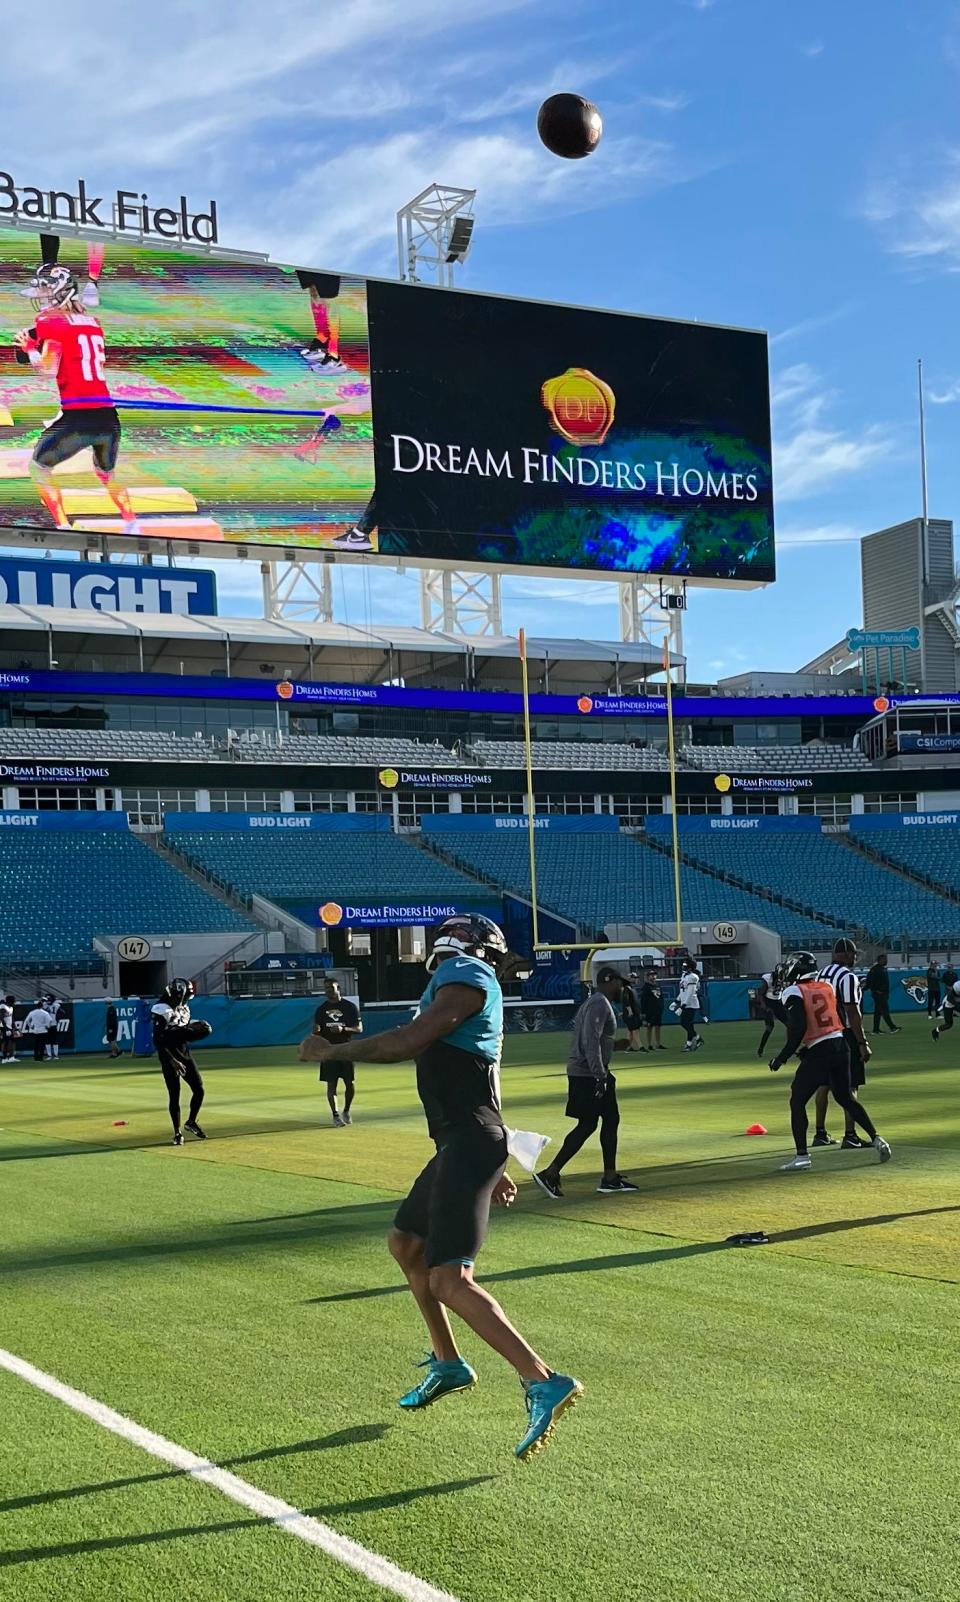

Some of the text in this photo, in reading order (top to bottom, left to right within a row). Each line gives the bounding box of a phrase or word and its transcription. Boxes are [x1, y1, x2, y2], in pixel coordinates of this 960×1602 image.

[0, 171, 218, 243] Bank Field
[391, 434, 758, 501] DREAM FINDERS HOMES
[18, 570, 198, 615] LIGHT
[865, 634, 879, 643] Pet
[296, 685, 322, 695] DREAM
[323, 686, 352, 697] FINDERS
[353, 688, 377, 698] HOMES
[594, 700, 618, 709] DREAM
[619, 700, 646, 710] FINDERS
[0, 765, 110, 777] DREAM FINDERS HOMES
[401, 773, 492, 784] DREAM FINDERS HOMES
[732, 777, 813, 787] DREAM FINDERS HOMES
[0, 815, 39, 826] LIGHT
[249, 817, 312, 827] BUD LIGHT
[495, 819, 518, 828] BUD
[710, 819, 760, 828] BUD LIGHT
[903, 815, 958, 825] BUD LIGHT
[346, 906, 456, 919] DREAM FINDERS HOMES
[717, 926, 733, 938] 149
[123, 942, 145, 955] 147
[535, 951, 552, 961] LIGHT
[812, 994, 834, 1027] 2
